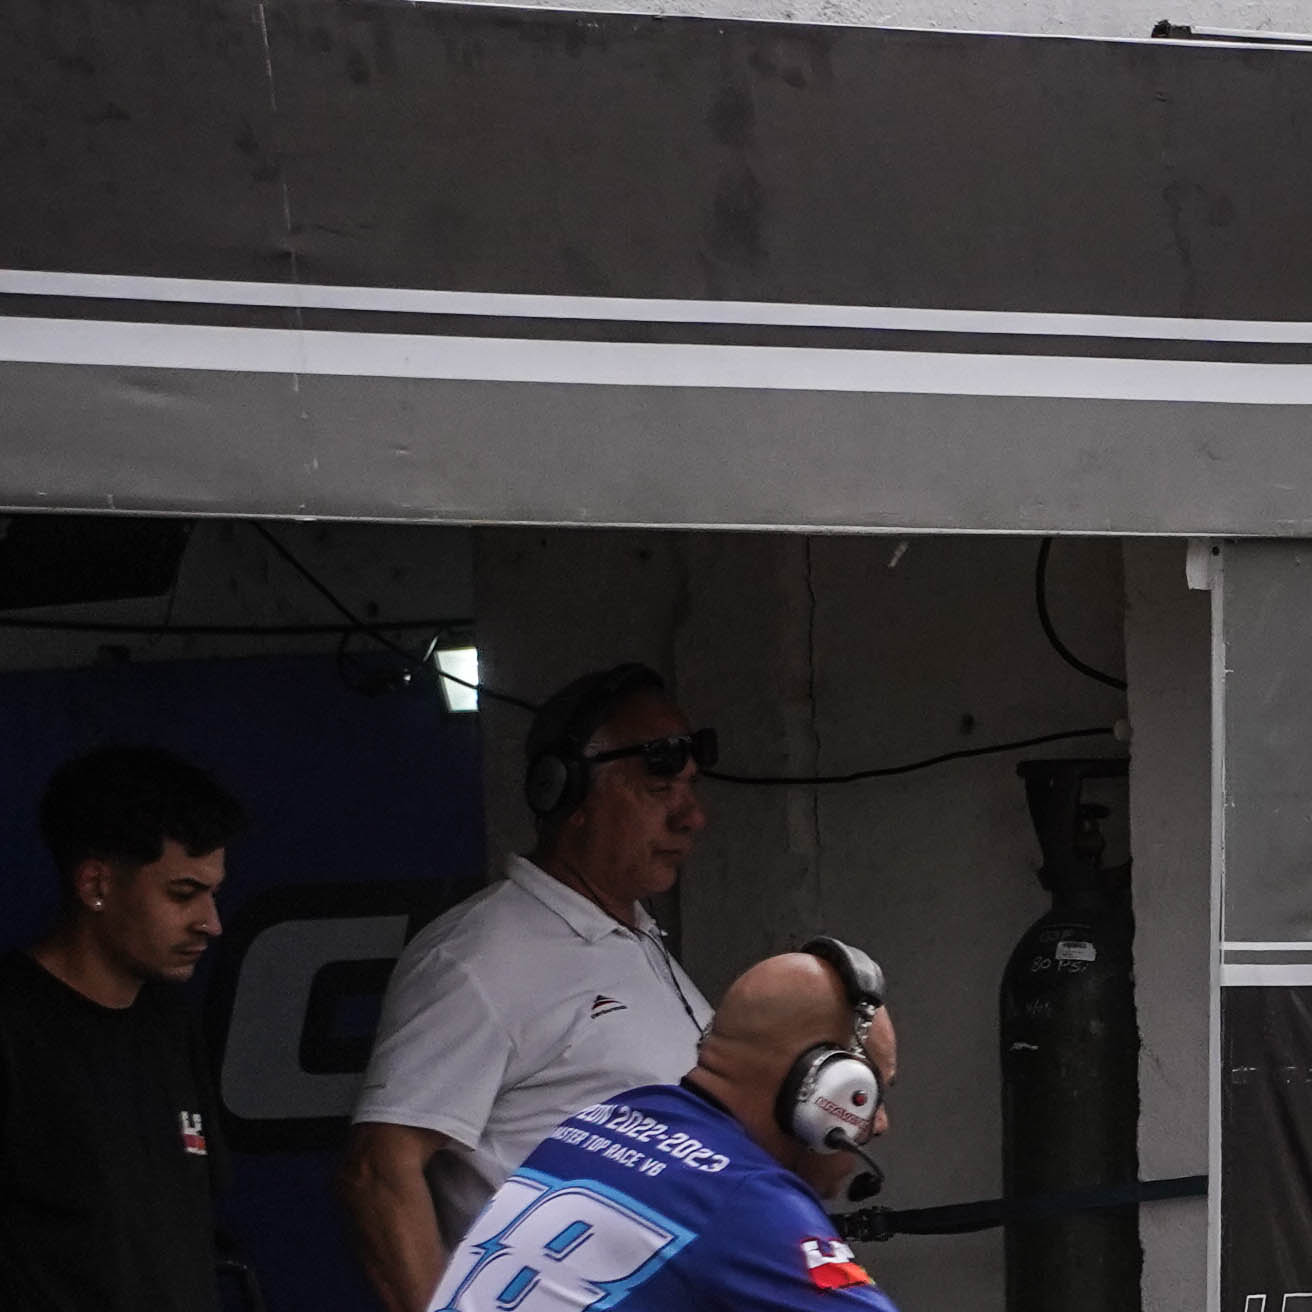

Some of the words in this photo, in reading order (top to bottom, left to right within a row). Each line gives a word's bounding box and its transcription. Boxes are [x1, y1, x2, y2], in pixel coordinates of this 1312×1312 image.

[579, 1133, 613, 1153] TOP
[602, 1142, 646, 1169] RACE
[637, 1157, 667, 1178] V6
[604, 1104, 731, 1173] 2022-2023
